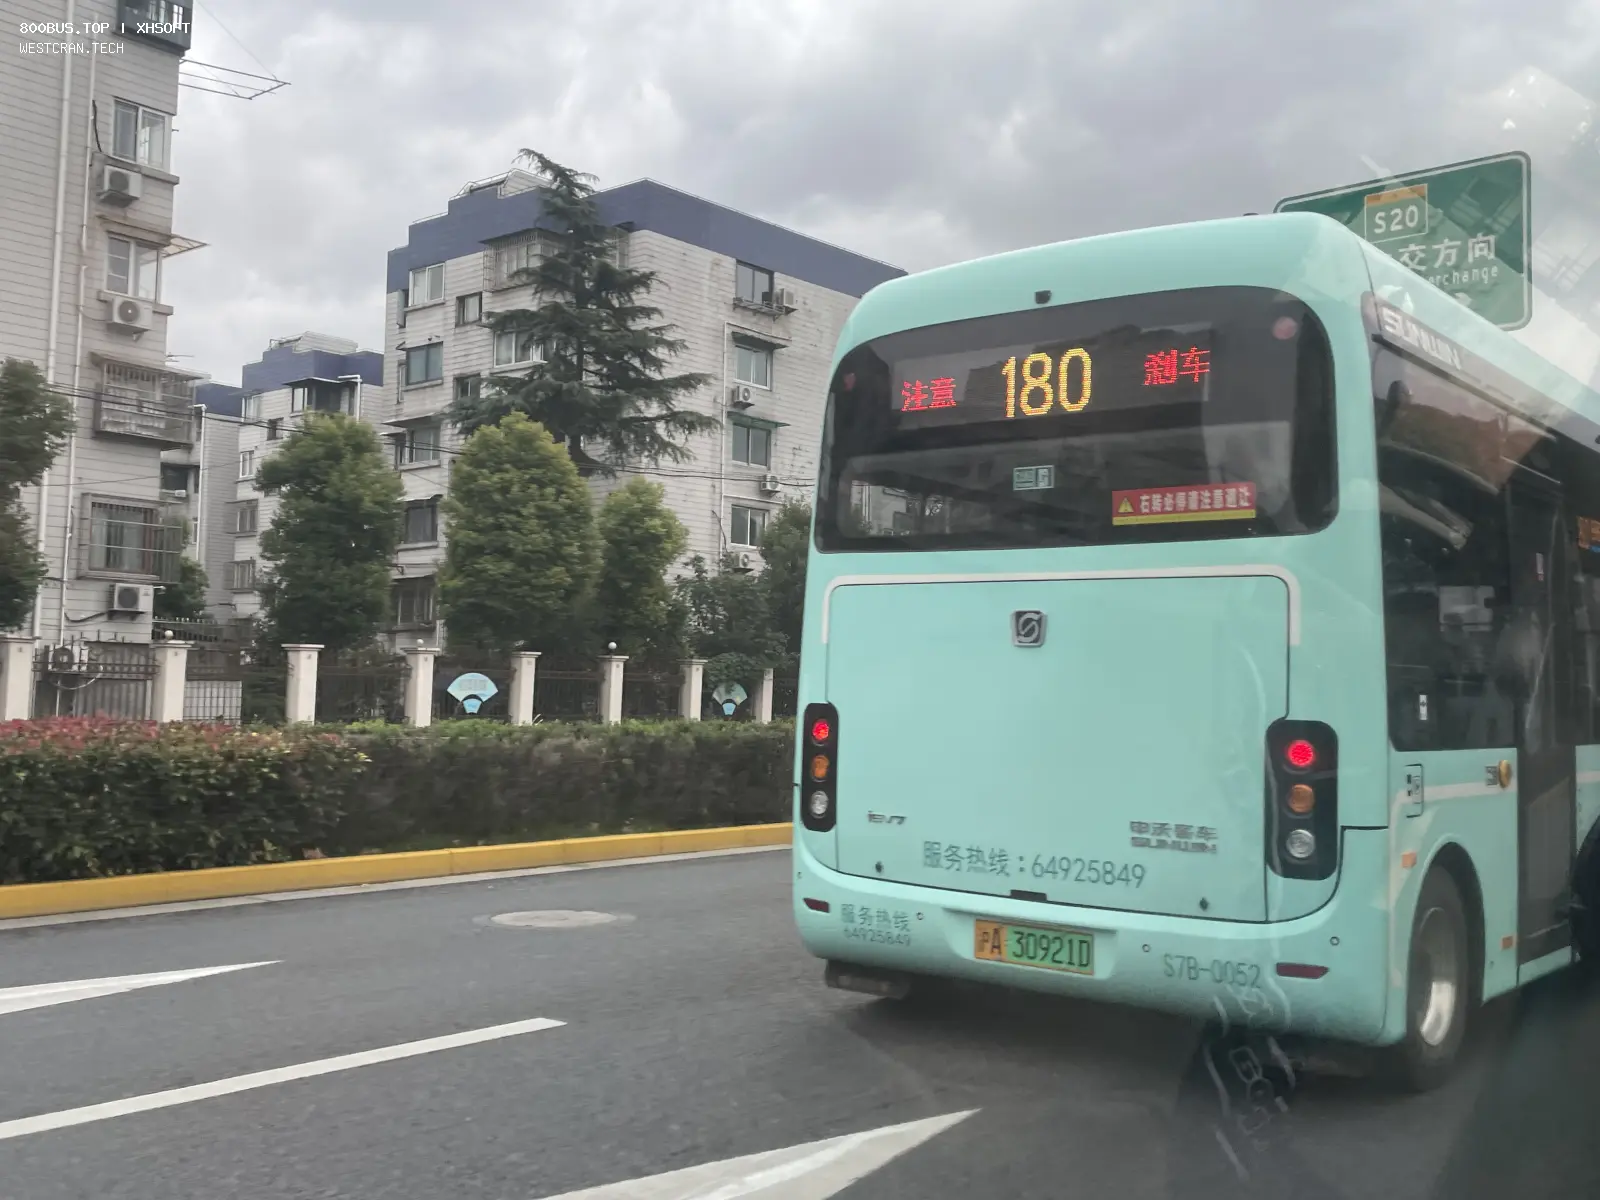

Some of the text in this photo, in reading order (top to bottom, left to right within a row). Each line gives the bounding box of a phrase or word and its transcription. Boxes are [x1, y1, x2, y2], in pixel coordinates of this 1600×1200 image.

[1374, 204, 1419, 234] S20
[1397, 232, 1496, 272] 交方向
[901, 377, 956, 412] 注意
[1002, 347, 1092, 418] 180
[841, 903, 910, 932] 服务热线
[1012, 929, 1091, 968] 30921D
[1163, 953, 1261, 989] S7B-0052
